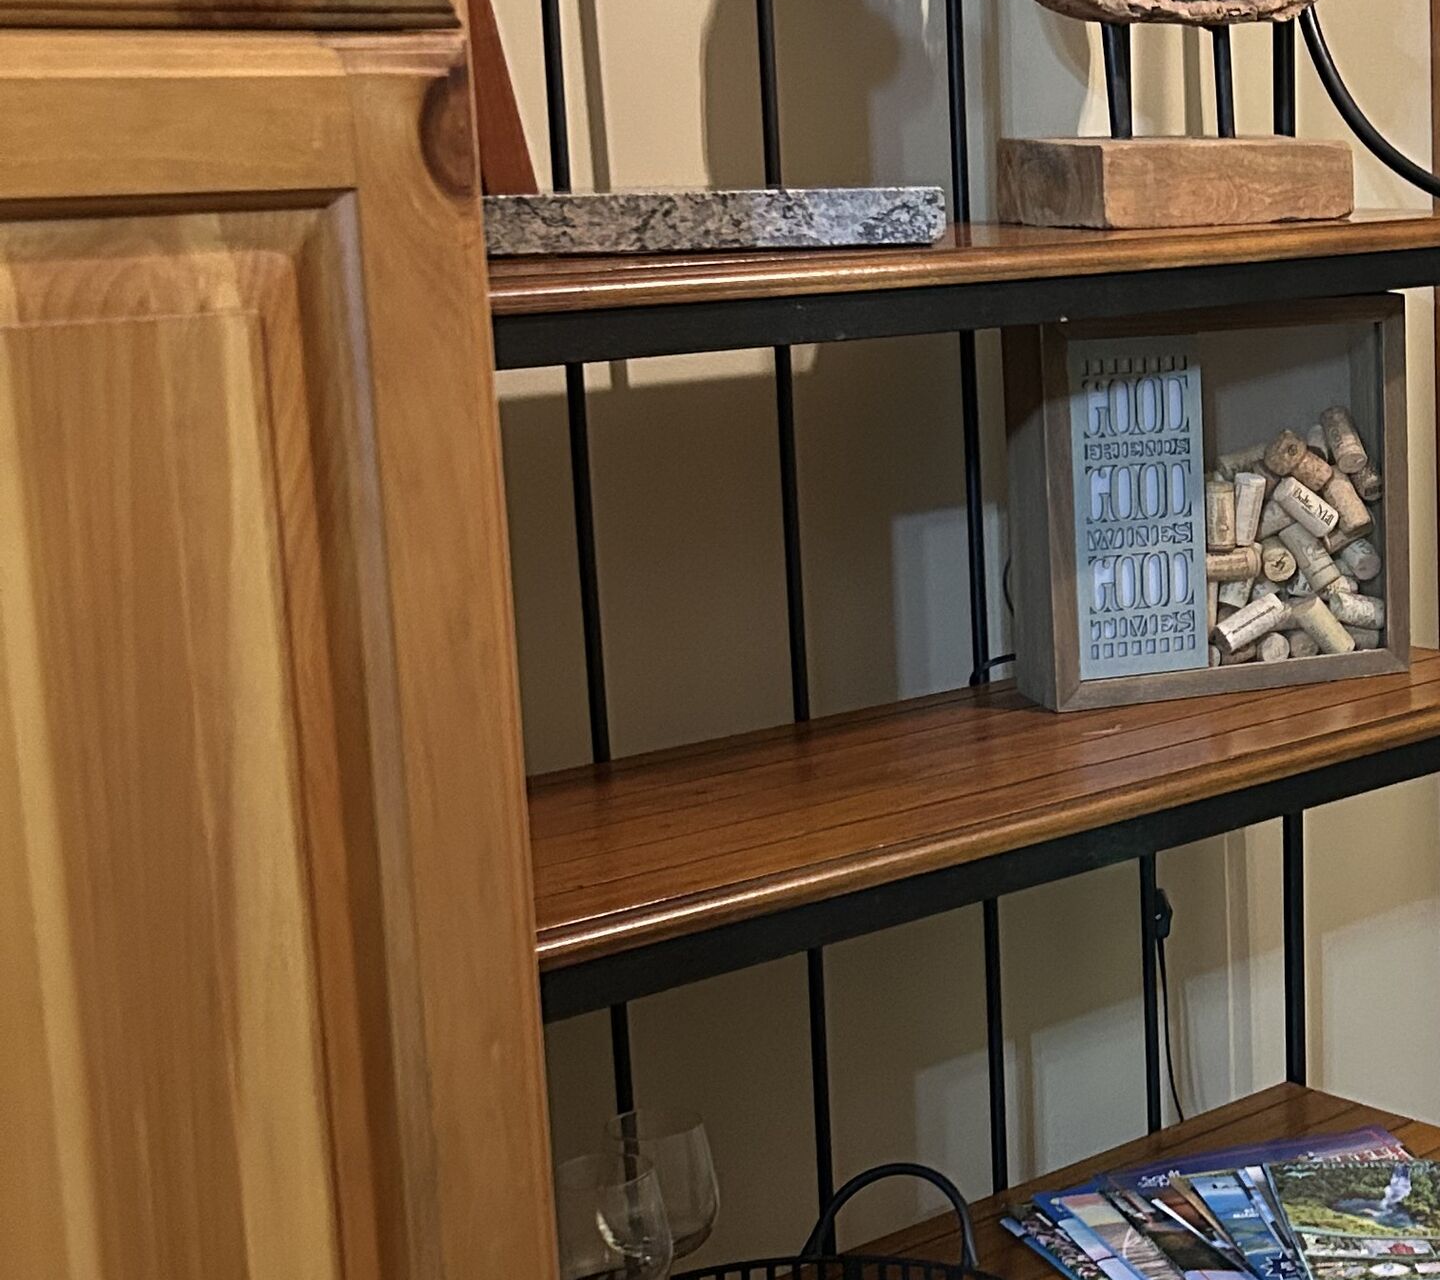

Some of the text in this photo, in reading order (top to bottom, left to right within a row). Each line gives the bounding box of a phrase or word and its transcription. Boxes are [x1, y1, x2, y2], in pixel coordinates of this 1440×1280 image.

[1083, 375, 1189, 439] GOOD
[1085, 437, 1191, 461] FRIENDS
[1085, 460, 1192, 524] GOOD
[1087, 521, 1193, 552] WINES
[1088, 548, 1195, 614] GOOD
[1090, 609, 1196, 641] TIMES
